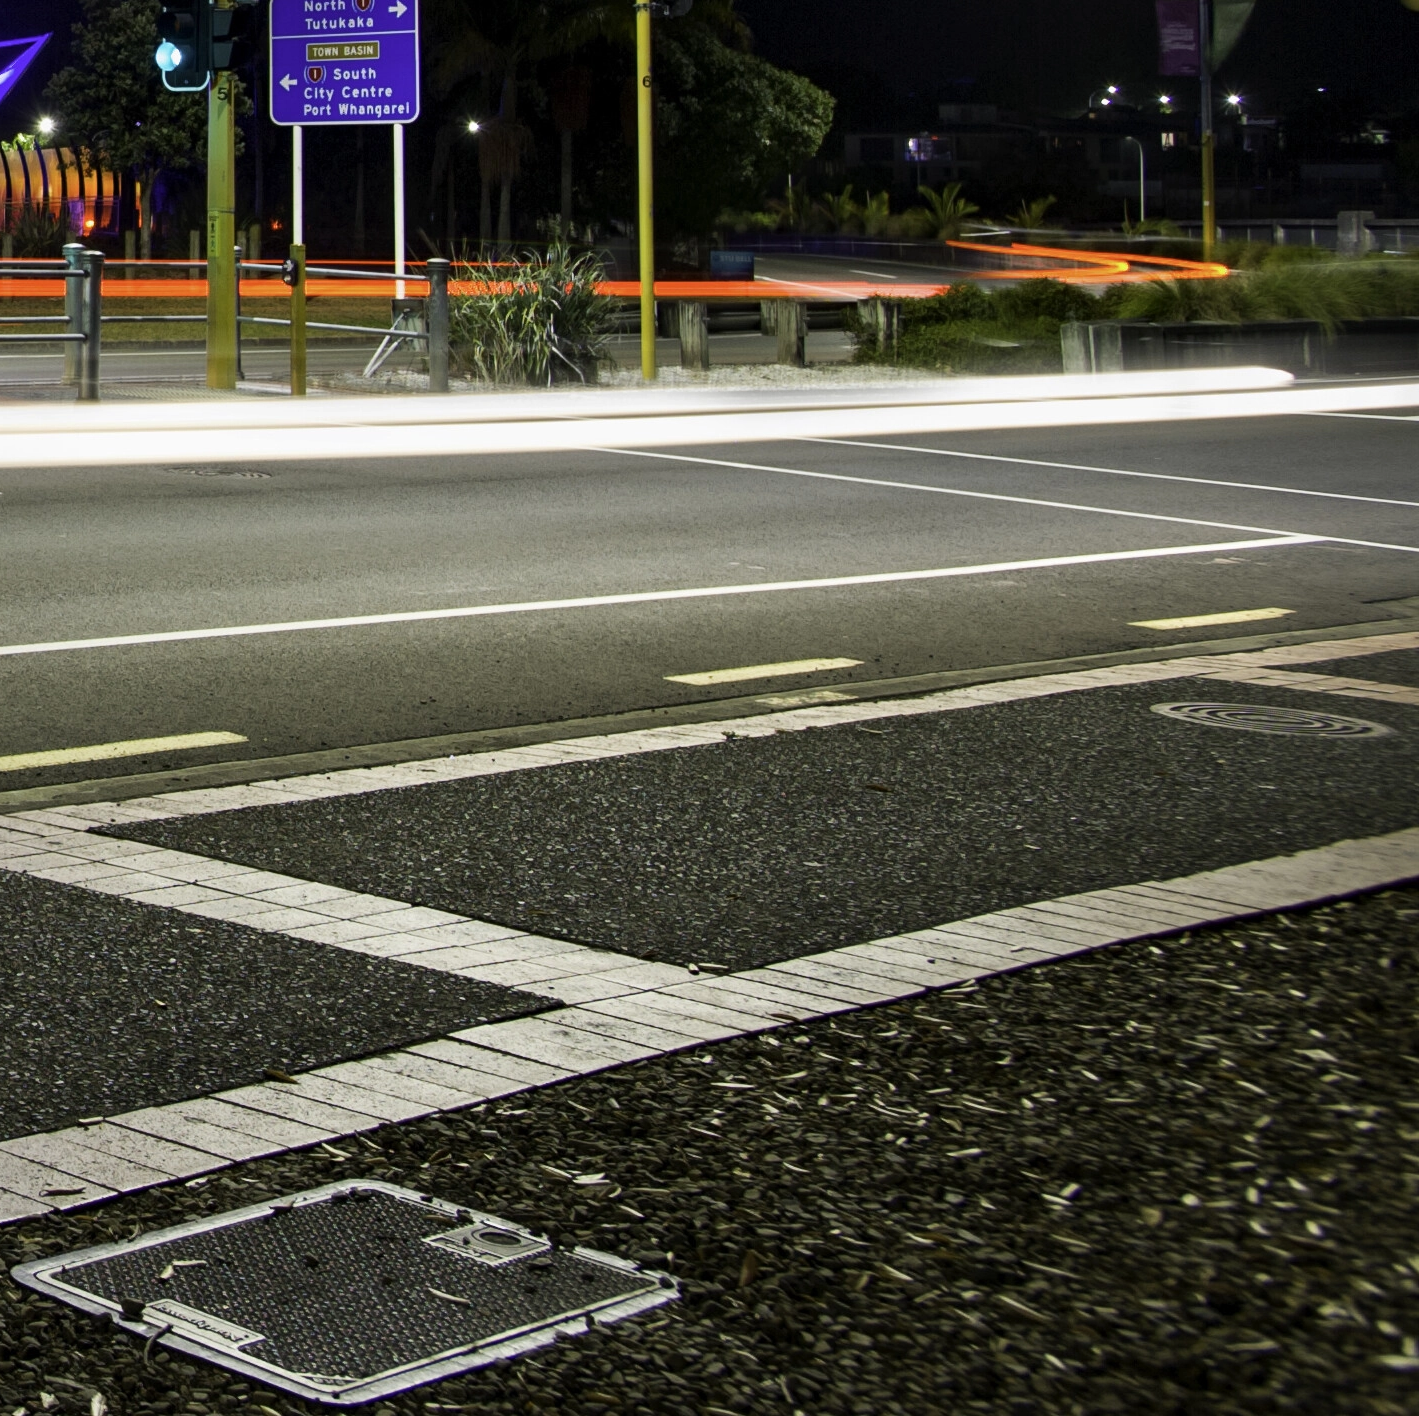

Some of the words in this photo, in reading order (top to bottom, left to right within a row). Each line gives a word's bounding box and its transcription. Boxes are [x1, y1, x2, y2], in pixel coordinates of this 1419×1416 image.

[304, 0, 346, 12] North
[305, 16, 374, 30] Tutukaka
[312, 46, 339, 57] TOWN
[343, 45, 374, 56] BASIN
[333, 67, 377, 81] South
[642, 75, 652, 88] 6
[217, 87, 229, 101] 5
[303, 86, 334, 102] City
[341, 85, 393, 99] Centre
[303, 103, 332, 116] Port
[338, 101, 410, 118] Whangarei
